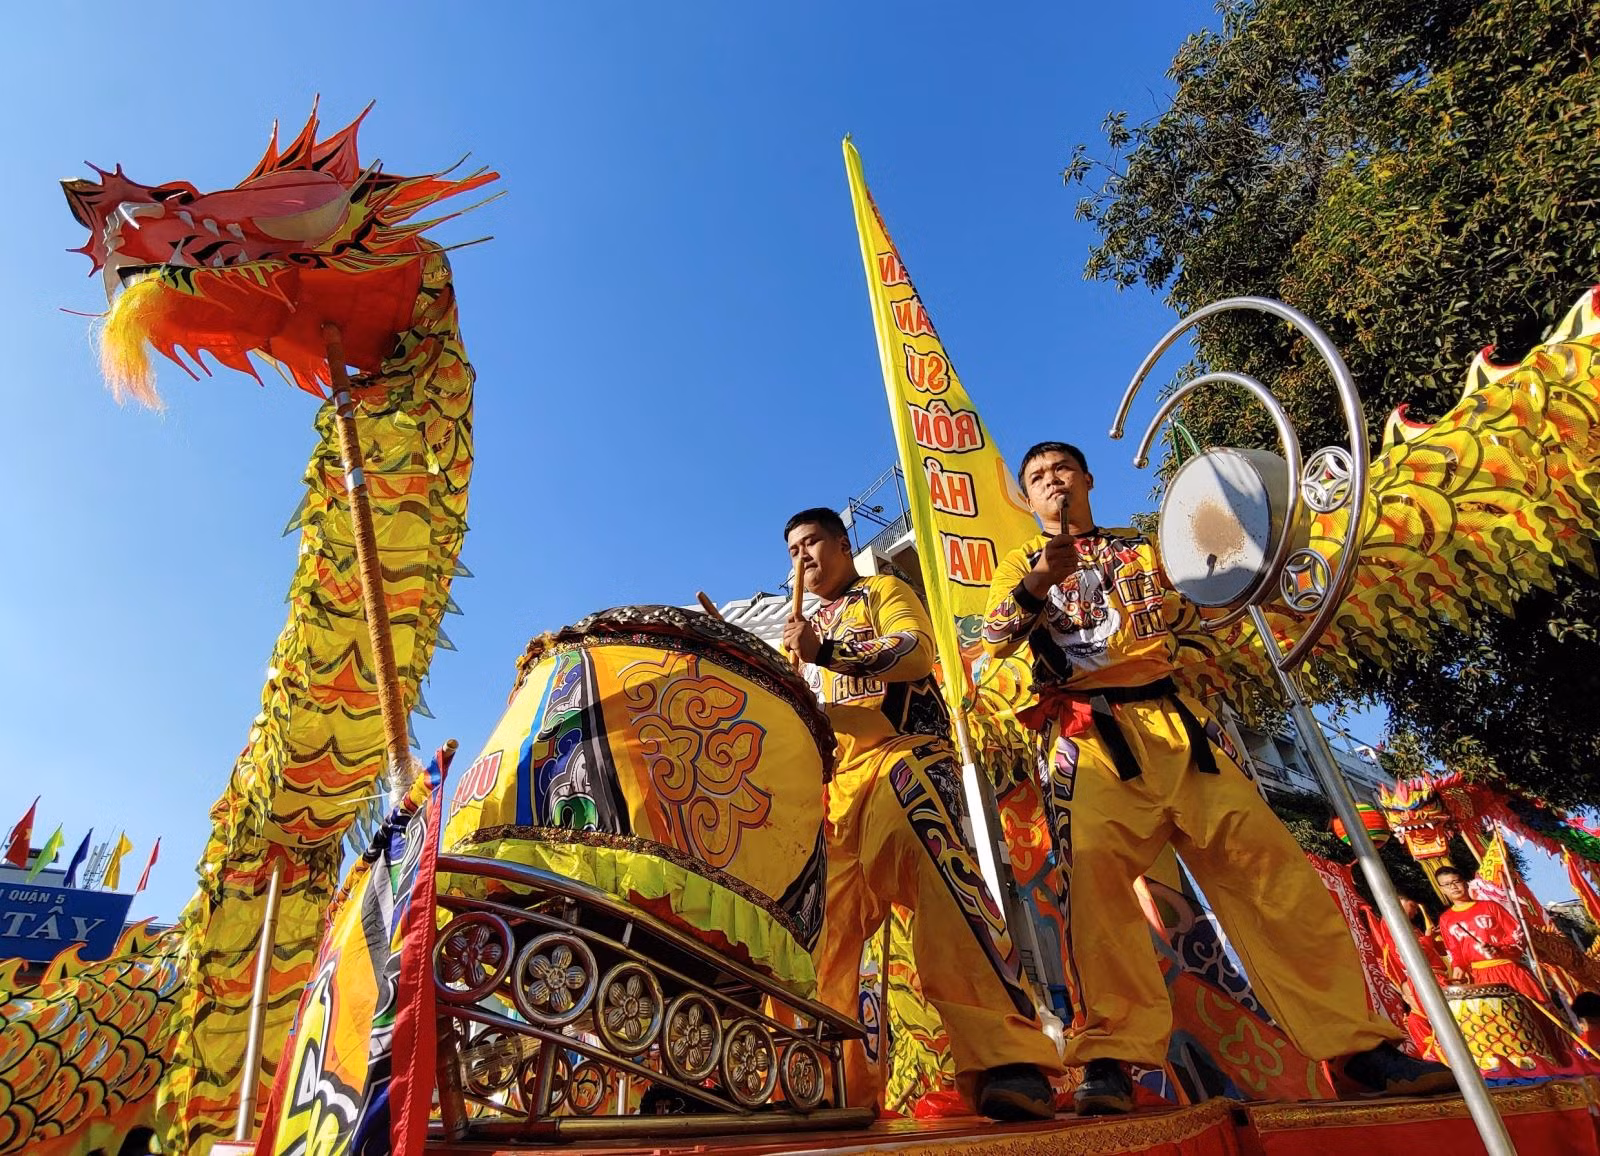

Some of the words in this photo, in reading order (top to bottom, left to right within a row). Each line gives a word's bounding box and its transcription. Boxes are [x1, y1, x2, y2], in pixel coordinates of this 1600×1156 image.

[8, 889, 50, 905] QUẬN
[55, 894, 66, 904] 5
[1, 906, 105, 942] TÂY
